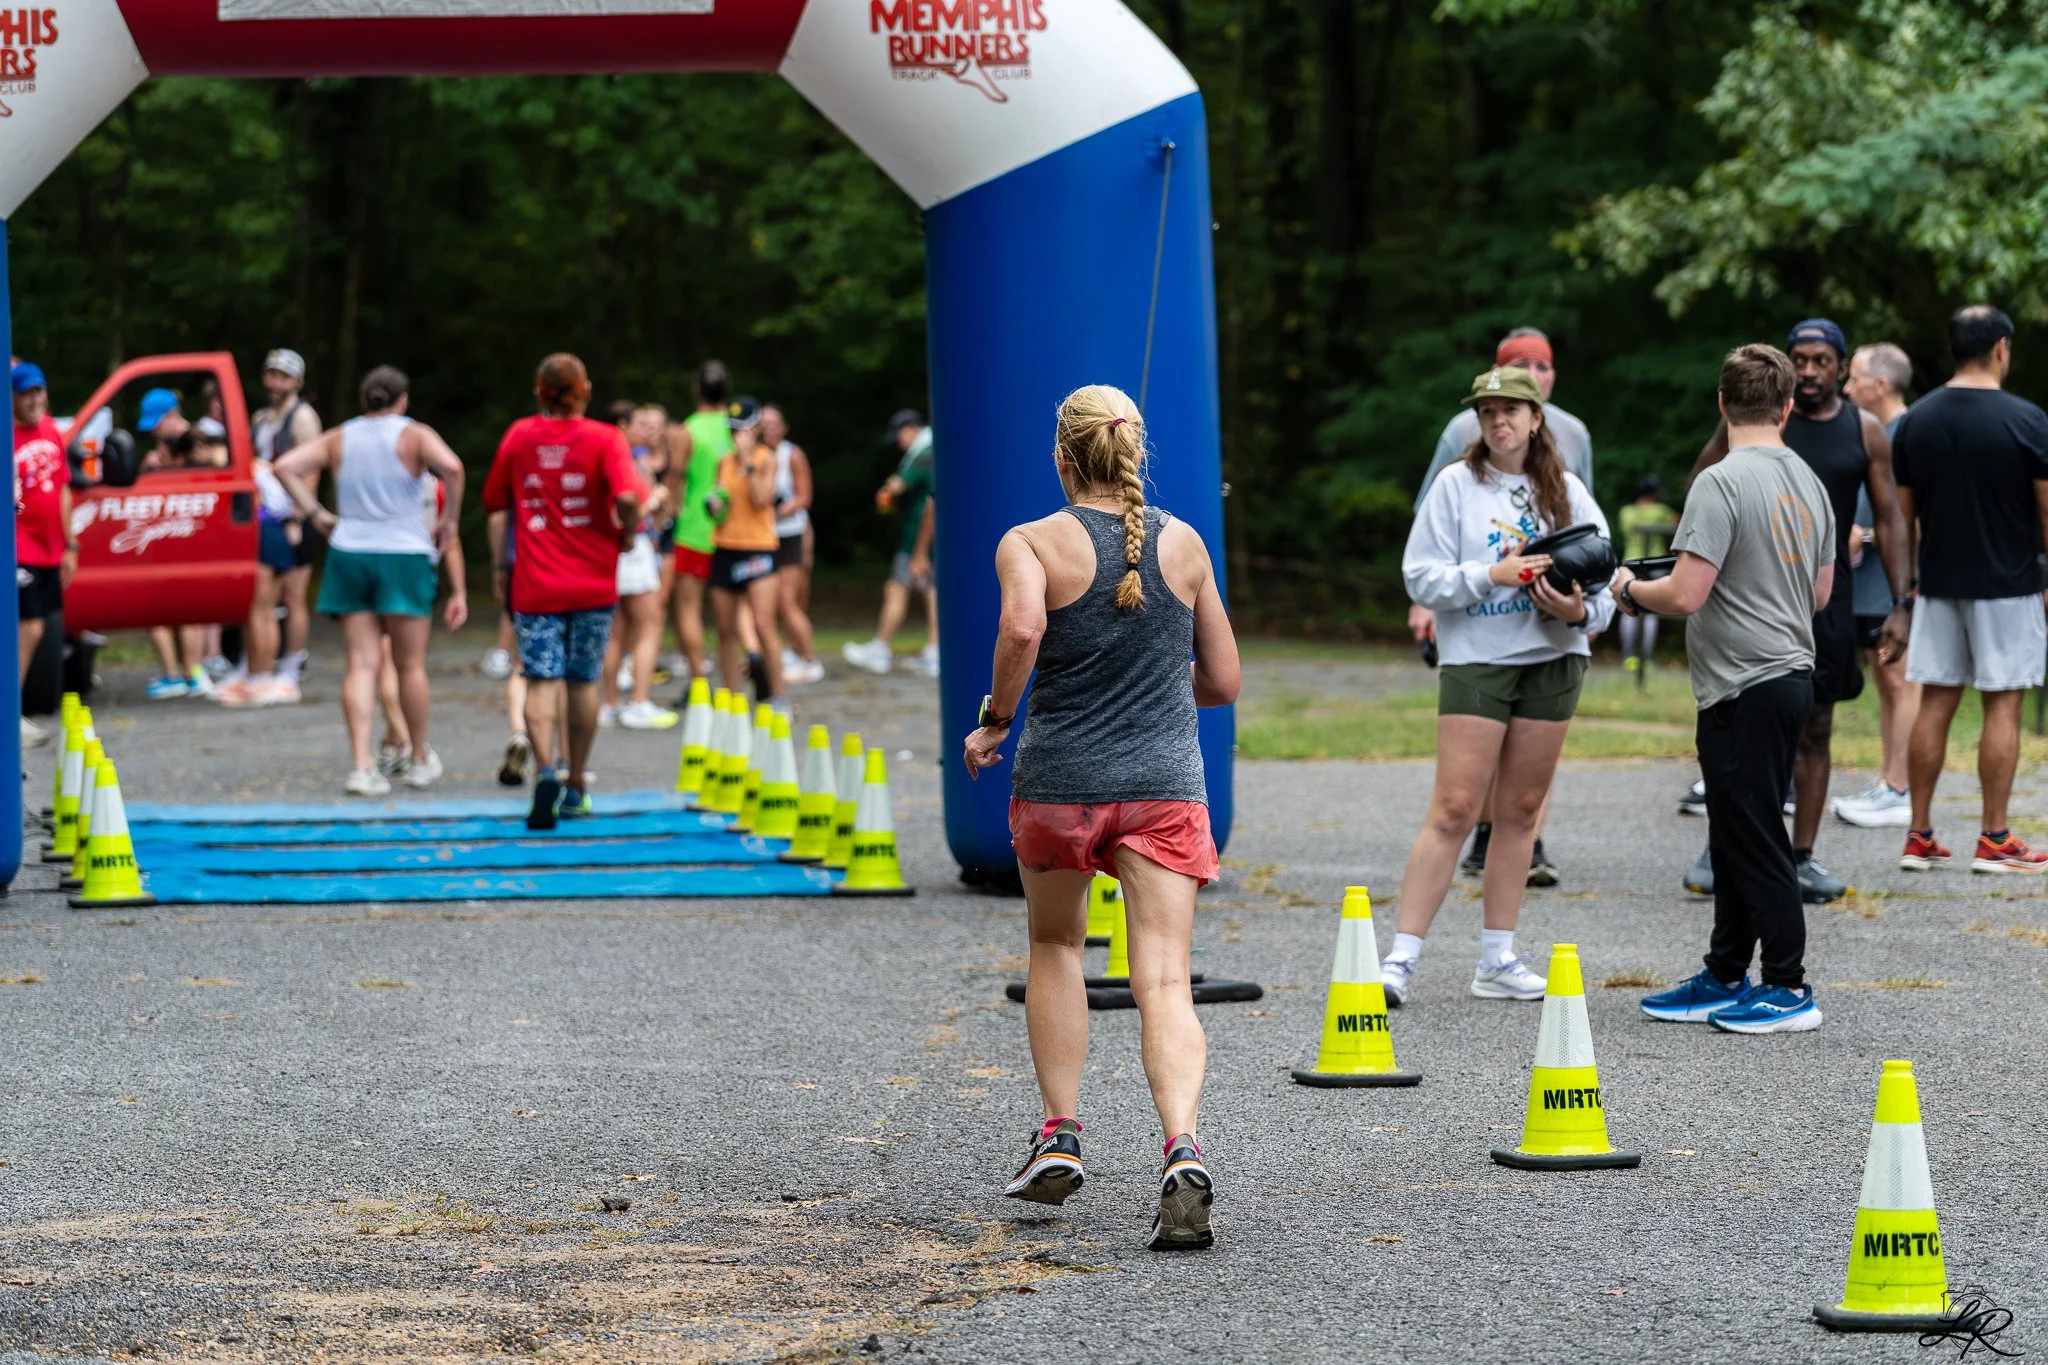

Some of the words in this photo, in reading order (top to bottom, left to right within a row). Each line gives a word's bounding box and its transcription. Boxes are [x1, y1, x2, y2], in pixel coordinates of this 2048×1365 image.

[869, 0, 1048, 33] MEMPHIS
[888, 34, 1031, 62] RUNNERS
[101, 496, 165, 521] FLEET
[163, 492, 219, 518] FEET
[1466, 599, 1538, 618] CALGAR
[1543, 1087, 1602, 1110] MRTC
[1864, 1231, 1941, 1258] MRTC
